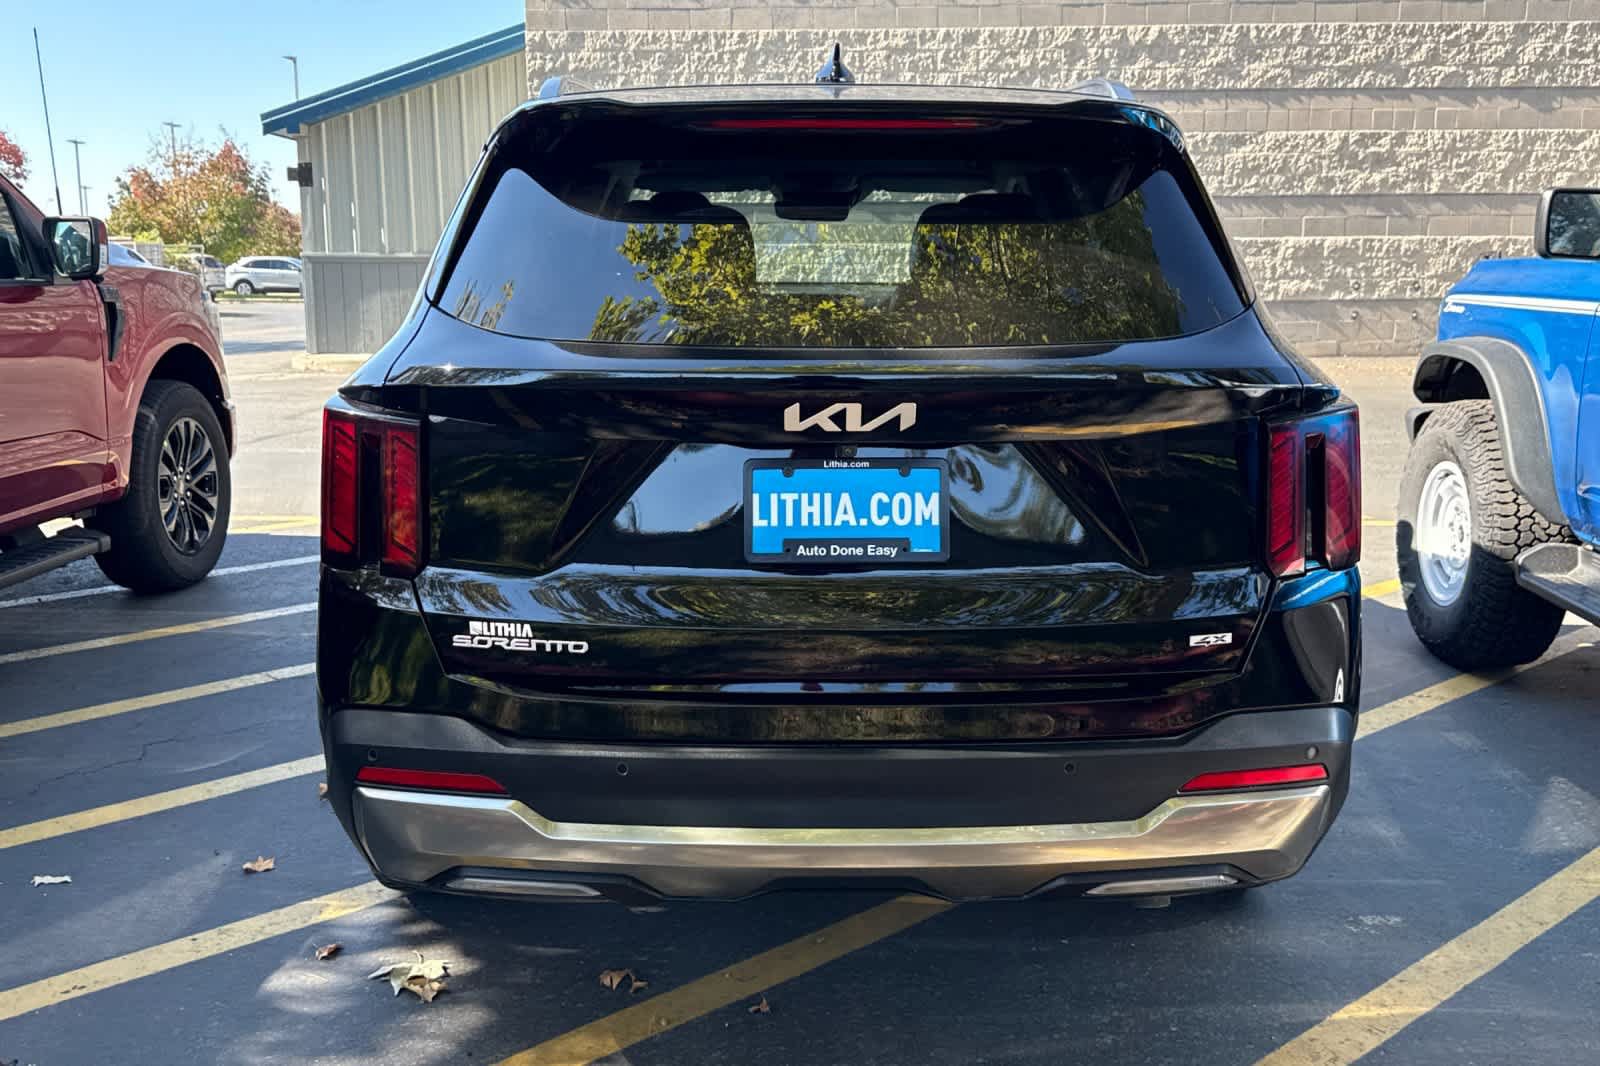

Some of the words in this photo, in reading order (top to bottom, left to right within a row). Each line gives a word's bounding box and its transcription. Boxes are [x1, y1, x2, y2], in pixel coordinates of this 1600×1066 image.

[784, 402, 917, 432] KIA
[823, 460, 870, 468] Lithia.com
[752, 492, 940, 527] LITHIA.COM
[797, 545, 827, 556] Auto
[831, 545, 864, 556] Done
[867, 545, 898, 557] Easy
[482, 621, 533, 637] LITHIA
[452, 635, 589, 653] SORENTO
